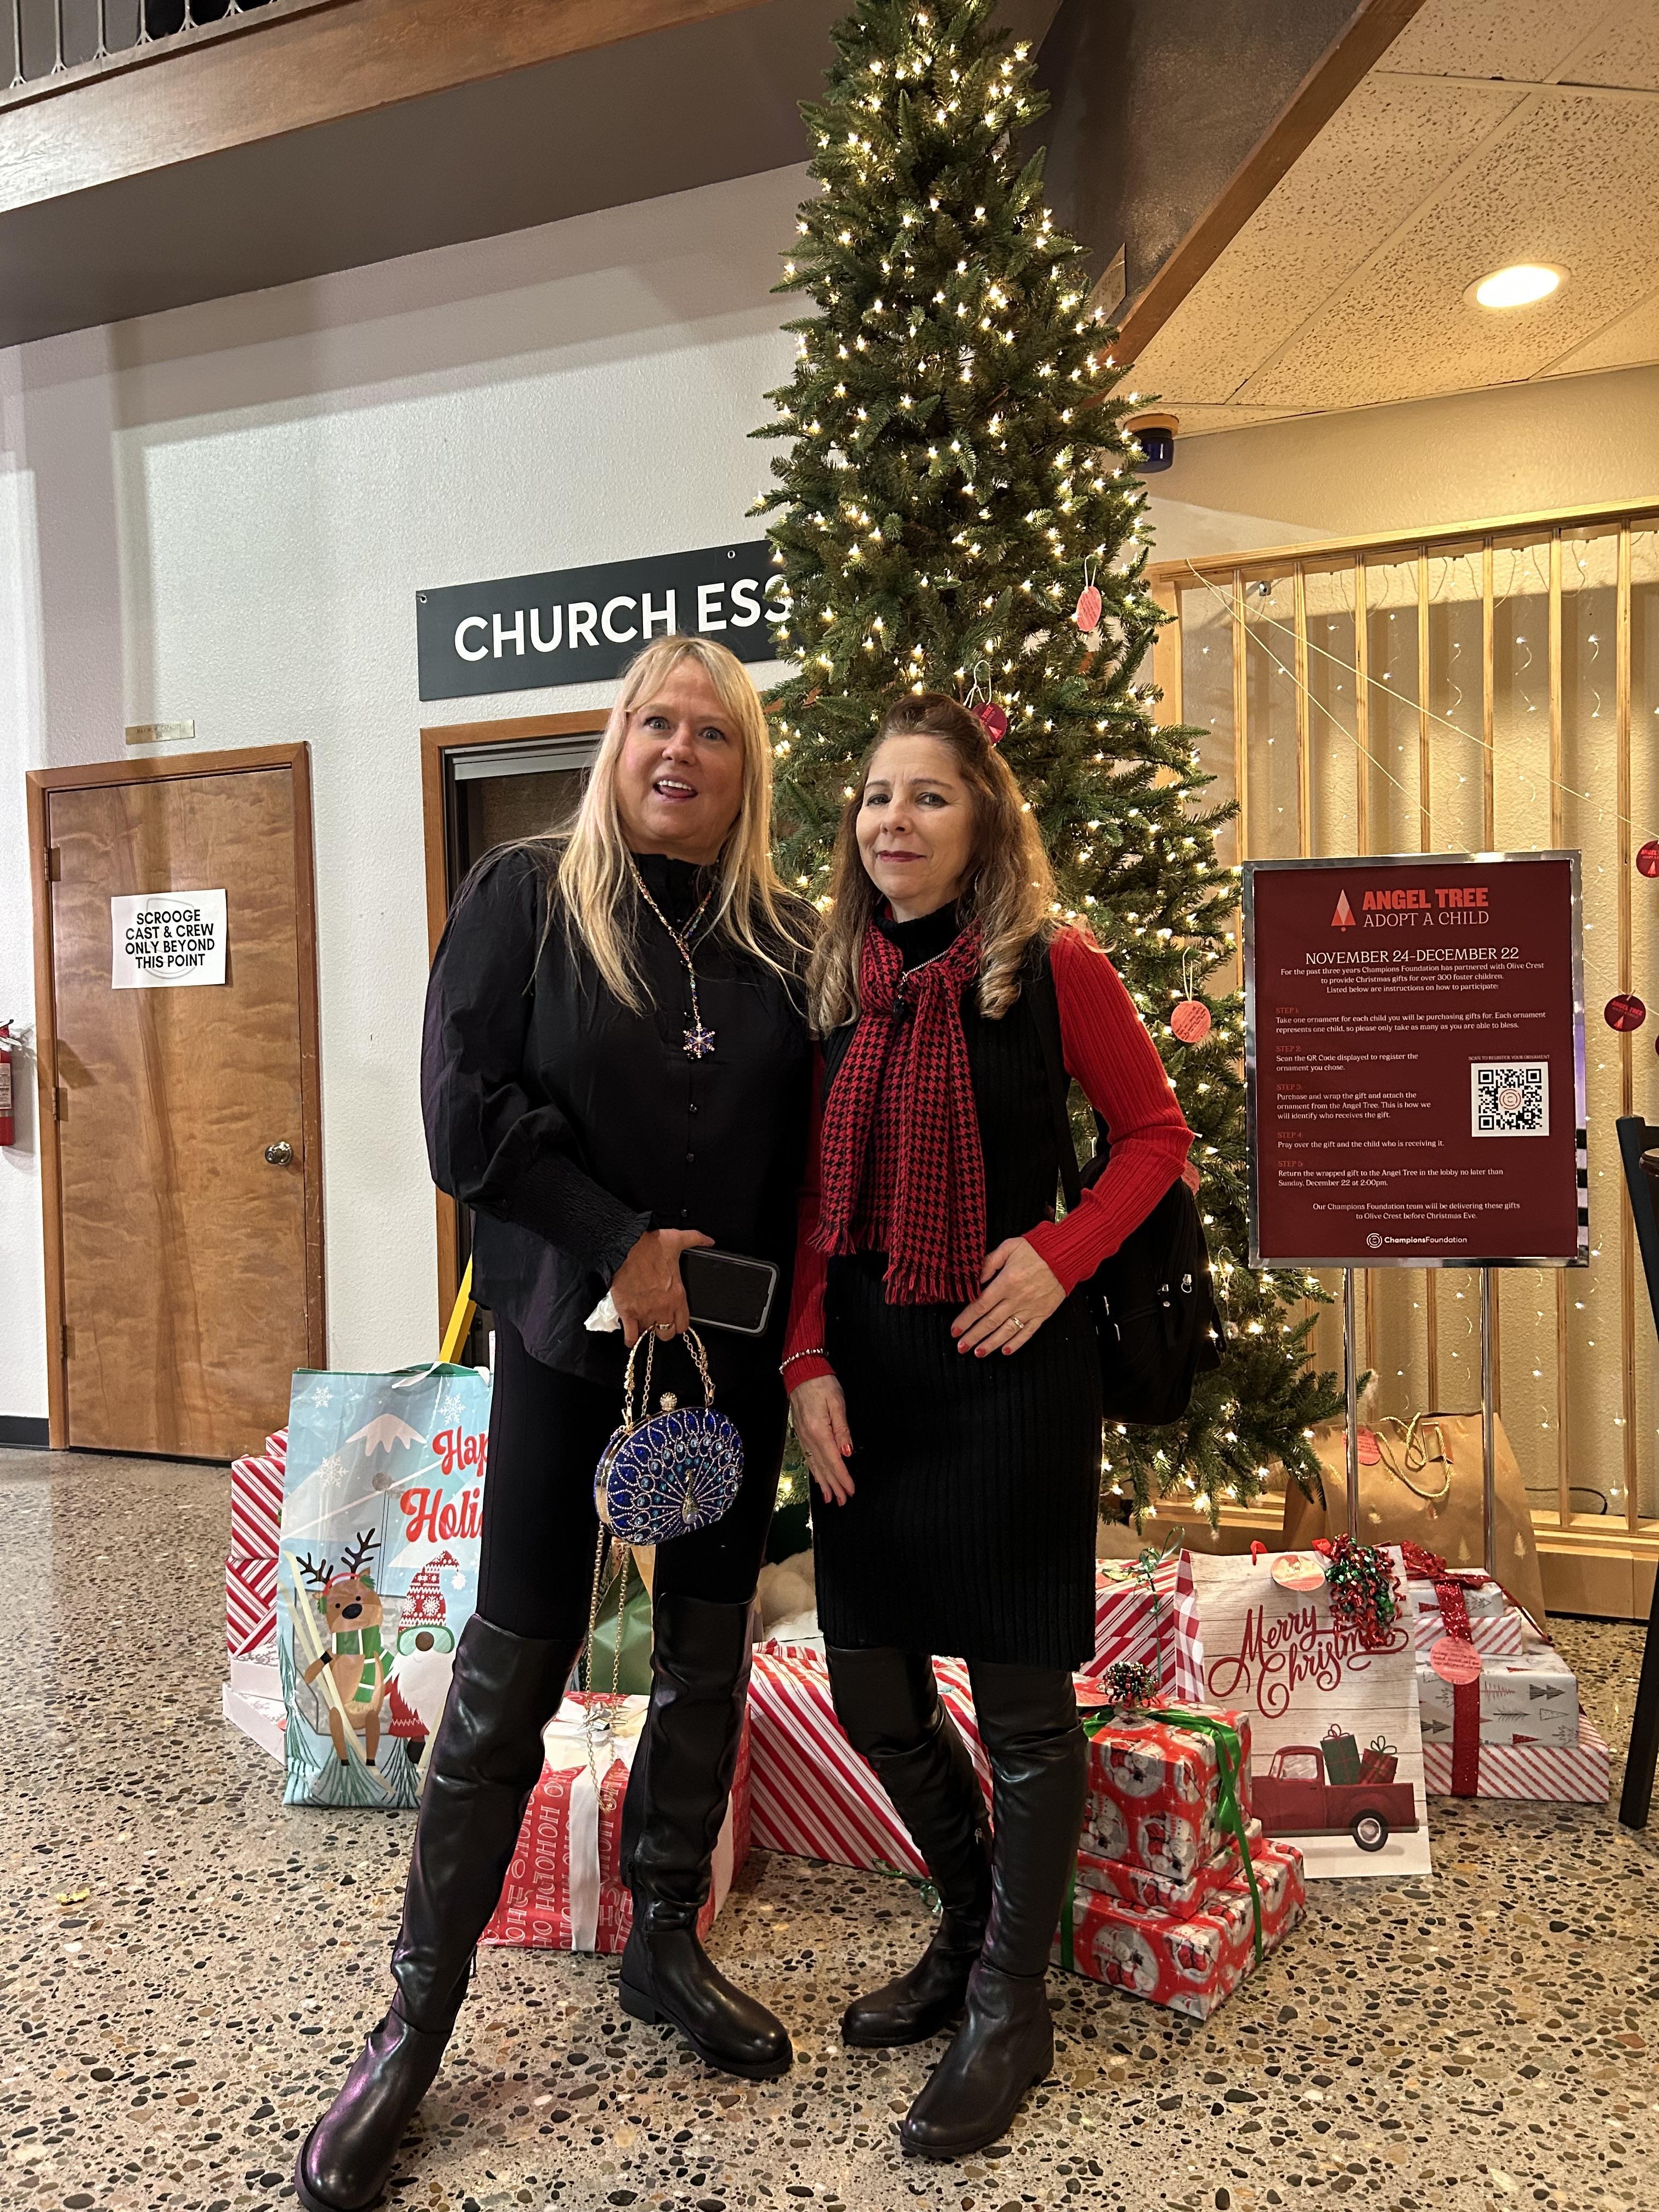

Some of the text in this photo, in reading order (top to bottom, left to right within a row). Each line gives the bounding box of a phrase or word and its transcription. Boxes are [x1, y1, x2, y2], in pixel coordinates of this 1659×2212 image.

[455, 589, 676, 662] CHURCH
[1362, 888, 1488, 910] ANGEL TREE
[137, 909, 200, 924] SCROOGE
[1363, 910, 1488, 928] ADOPT A CHILD
[126, 923, 213, 940] CAST & CREW
[125, 938, 215, 955] ONLY BEYOND
[136, 953, 205, 968] THIS POINT
[1305, 951, 1389, 964] NOVEMBER
[1501, 947, 1519, 959] 22
[1306, 968, 1321, 976] past
[1362, 966, 1400, 975] Champions
[1454, 963, 1488, 972] partnered
[1329, 977, 1355, 985] provide
[1391, 975, 1408, 984] gifts
[1426, 1013, 1464, 1022] purchasing
[1465, 1013, 1480, 1021] gifts
[1336, 1054, 1369, 1063] displayed
[1379, 1053, 1406, 1062] register
[1355, 1092, 1367, 1101] gift
[1342, 1102, 1361, 1110] Angel
[1291, 1112, 1318, 1121] identify
[1376, 1111, 1391, 1120] gift.
[1278, 1141, 1293, 1149] Pray
[1323, 1141, 1335, 1149] gift
[1316, 1170, 1345, 1178] wrapped
[1346, 1170, 1359, 1178] gift
[1381, 1169, 1401, 1177] Angel
[1440, 1169, 1458, 1177] lobby
[1360, 1179, 1388, 1187] 2:00pm.
[1328, 1204, 1365, 1212] Champions
[1449, 1203, 1483, 1211] delivering
[1504, 1202, 1520, 1211] gifts
[1384, 1236, 1467, 1245] ChampionsFoundation
[400, 1487, 483, 1543] Holi
[1208, 1605, 1317, 1697] Merry
